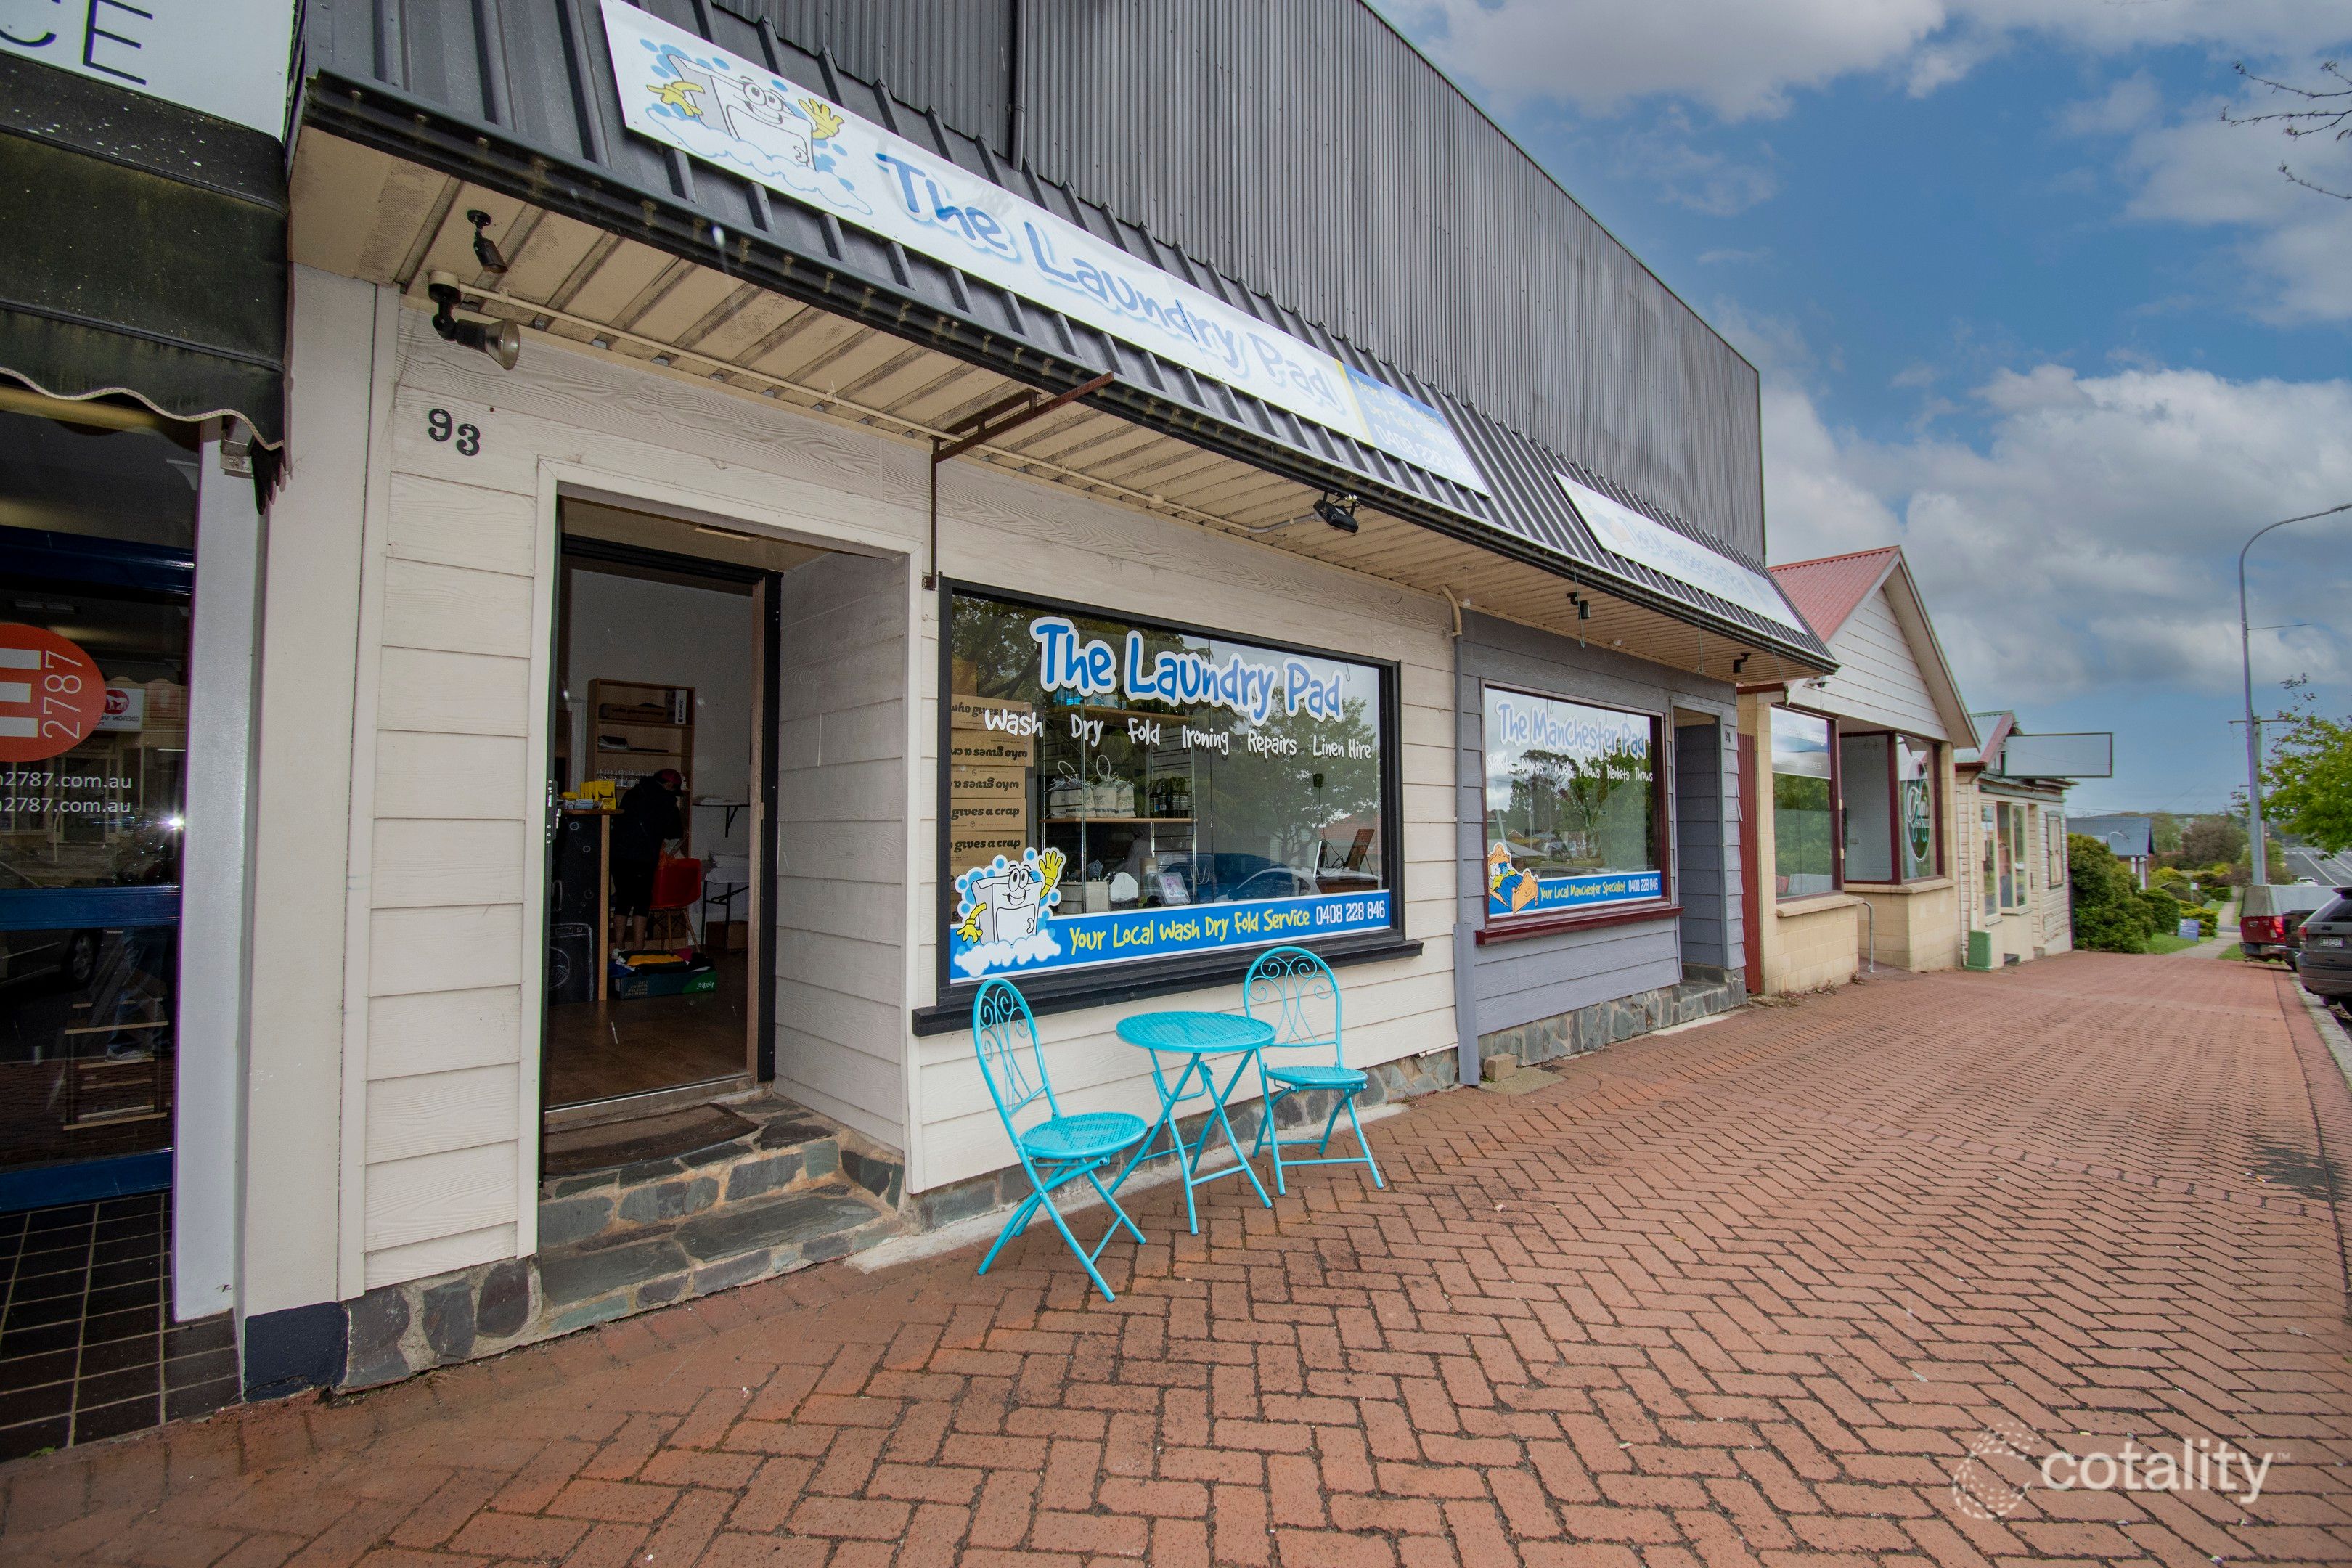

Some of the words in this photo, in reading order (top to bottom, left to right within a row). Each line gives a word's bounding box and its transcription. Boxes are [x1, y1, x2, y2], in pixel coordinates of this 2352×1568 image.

[875, 152, 1010, 253] The
[1024, 221, 1238, 365] Laundry
[1247, 332, 1340, 408] Pad
[428, 408, 481, 456] 93
[1034, 621, 1114, 693] The
[1127, 633, 1276, 724] Laundry
[1284, 660, 1342, 719] Pad
[42, 650, 82, 739] 2787
[984, 708, 1044, 738] Wash
[1070, 714, 1104, 747] Dry
[1127, 717, 1161, 746] Fold
[1182, 724, 1229, 756] Ironing
[1247, 729, 1298, 759] Repairs
[1312, 735, 1344, 758] Linen
[1348, 738, 1372, 759] Hire
[1497, 701, 1529, 744] The
[1532, 707, 1619, 759] Manchester
[1620, 720, 1646, 759] Pad
[973, 746, 1004, 756] gives
[1005, 749, 1028, 760] who
[963, 777, 995, 788] gives
[1551, 759, 1572, 776] Towels
[1579, 764, 1601, 779] Pillows
[1606, 764, 1630, 783] Blankets
[1635, 767, 1654, 783] Throws
[996, 780, 1019, 792] who
[0, 797, 131, 813] 2787.com.au
[951, 808, 984, 820] gives
[995, 807, 1020, 817] crap
[954, 840, 987, 852] gives
[997, 839, 1021, 849] crap
[1540, 887, 1553, 902] Your
[1554, 885, 1569, 899] Local
[1570, 883, 1601, 897] Manchester
[1602, 881, 1626, 897] Specialist
[1628, 879, 1640, 893] 0408
[1641, 878, 1649, 891] 228
[1649, 878, 1659, 891] 846
[1069, 927, 1106, 955] Your
[1113, 920, 1154, 948] Local
[1159, 918, 1200, 942] Wash
[1205, 916, 1229, 942] Dry
[1234, 910, 1259, 934] Fold
[1264, 909, 1310, 931] Service
[1315, 904, 1343, 926] 0408
[1346, 902, 1364, 922] 228
[1367, 900, 1386, 920] 846
